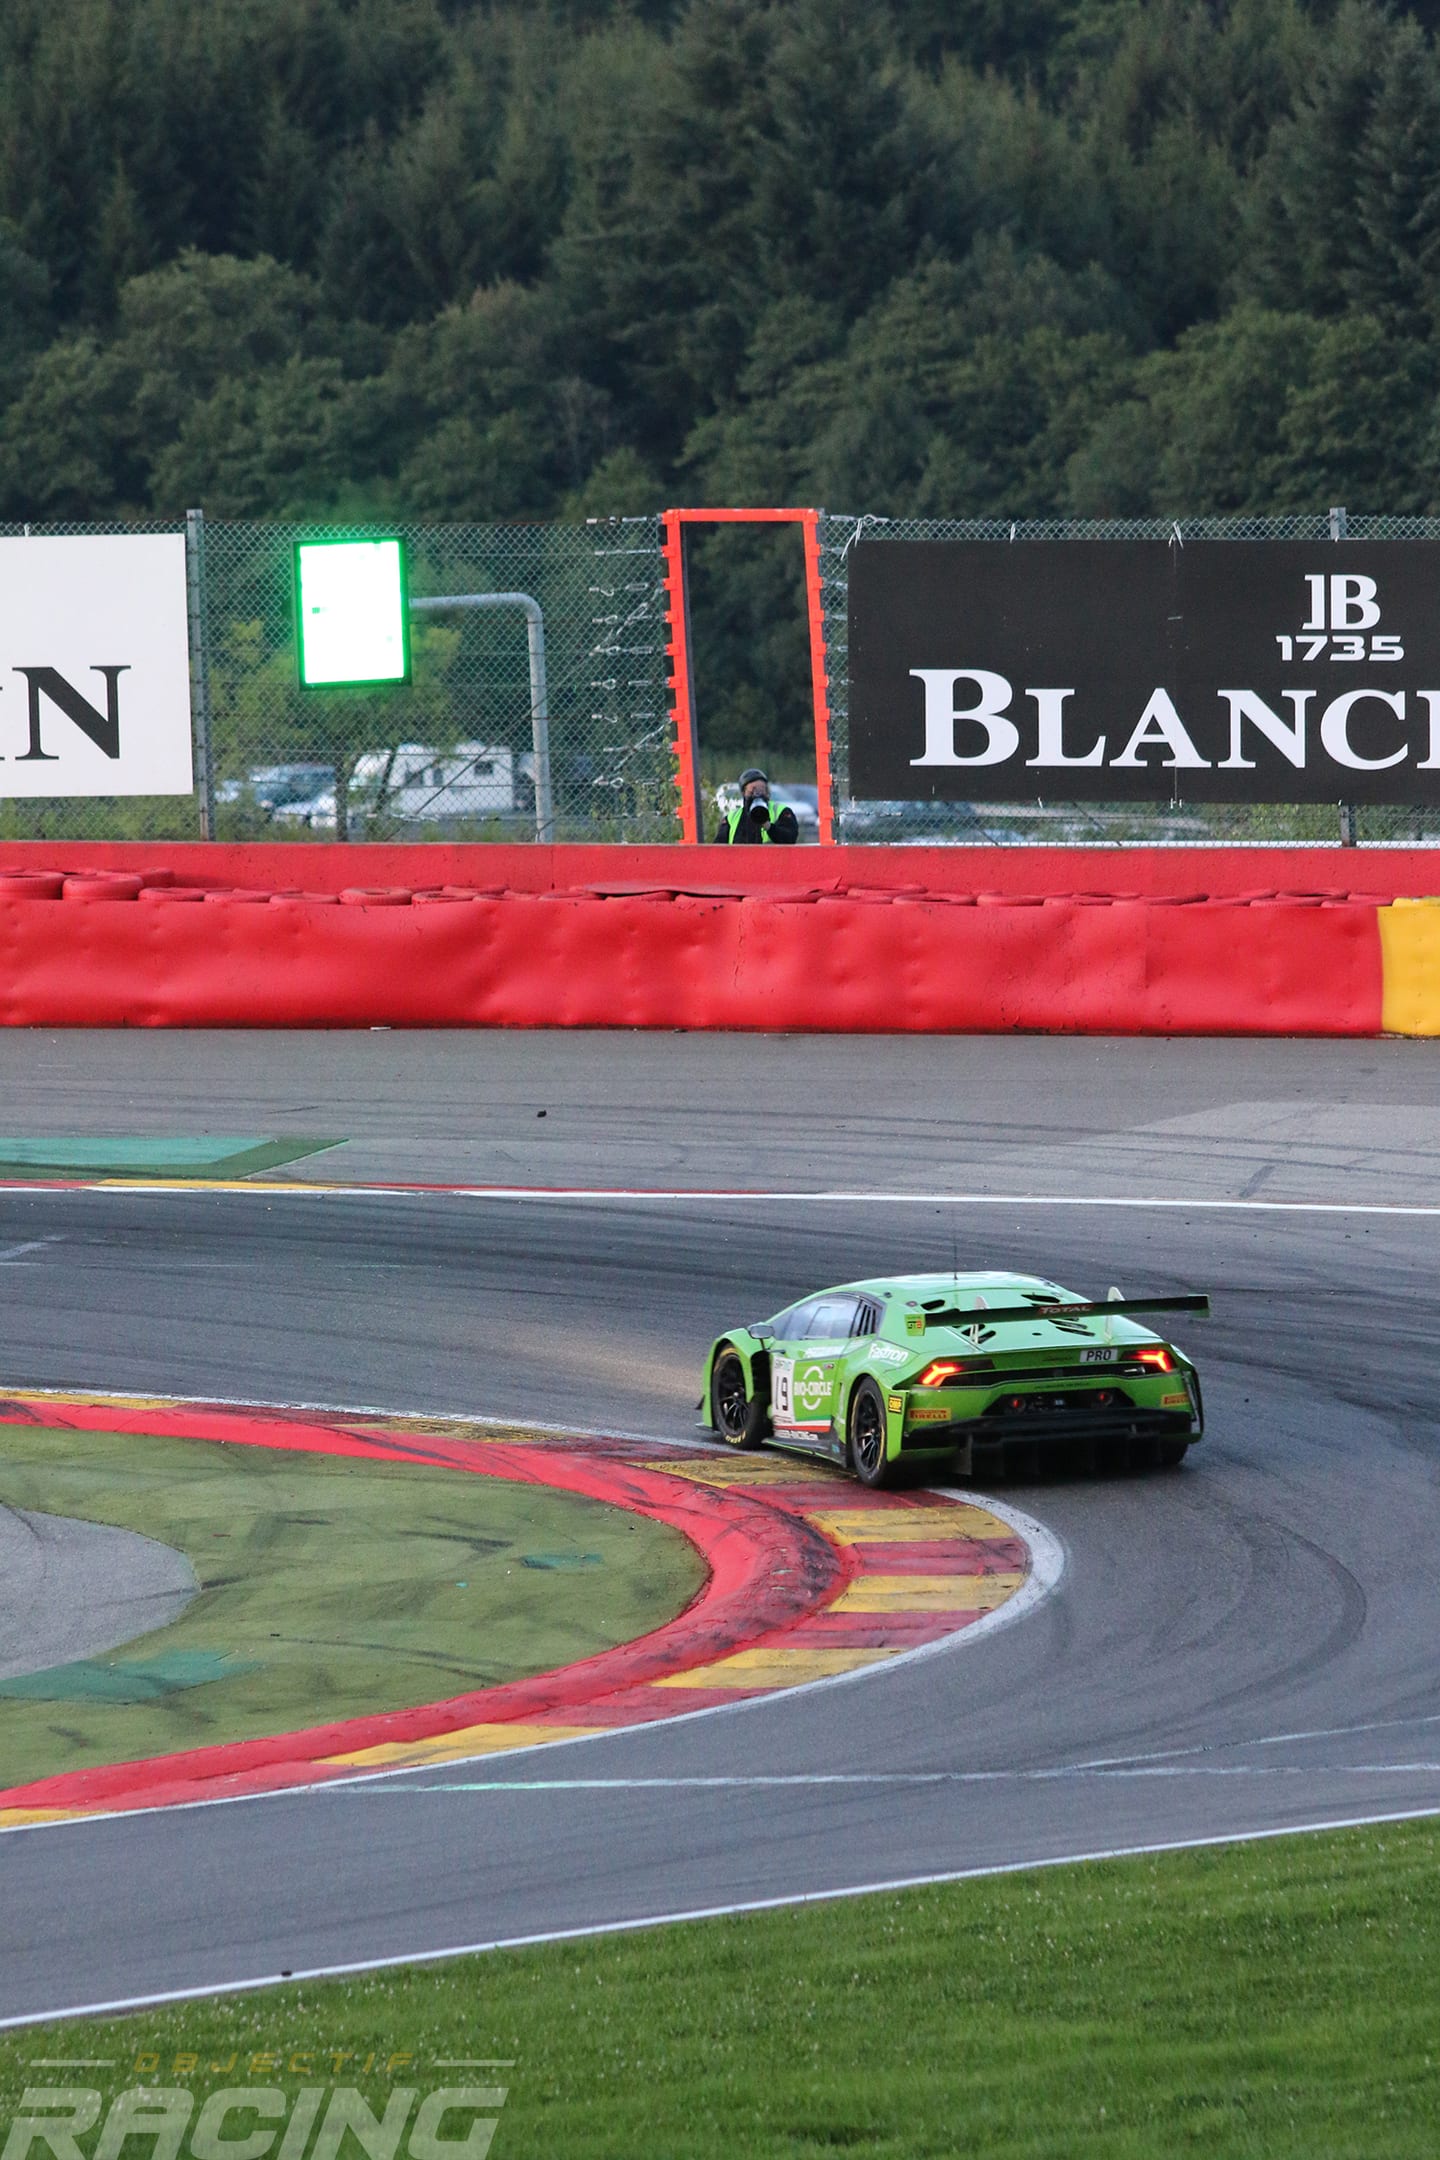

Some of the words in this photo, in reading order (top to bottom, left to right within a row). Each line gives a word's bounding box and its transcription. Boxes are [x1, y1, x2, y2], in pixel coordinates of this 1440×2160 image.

[1275, 635, 1404, 661] 1735
[0, 664, 131, 761] N
[908, 668, 1440, 769] BLANC
[868, 1343, 909, 1362] Fastron
[1085, 1350, 1112, 1362] PRO
[775, 1375, 789, 1411] 19
